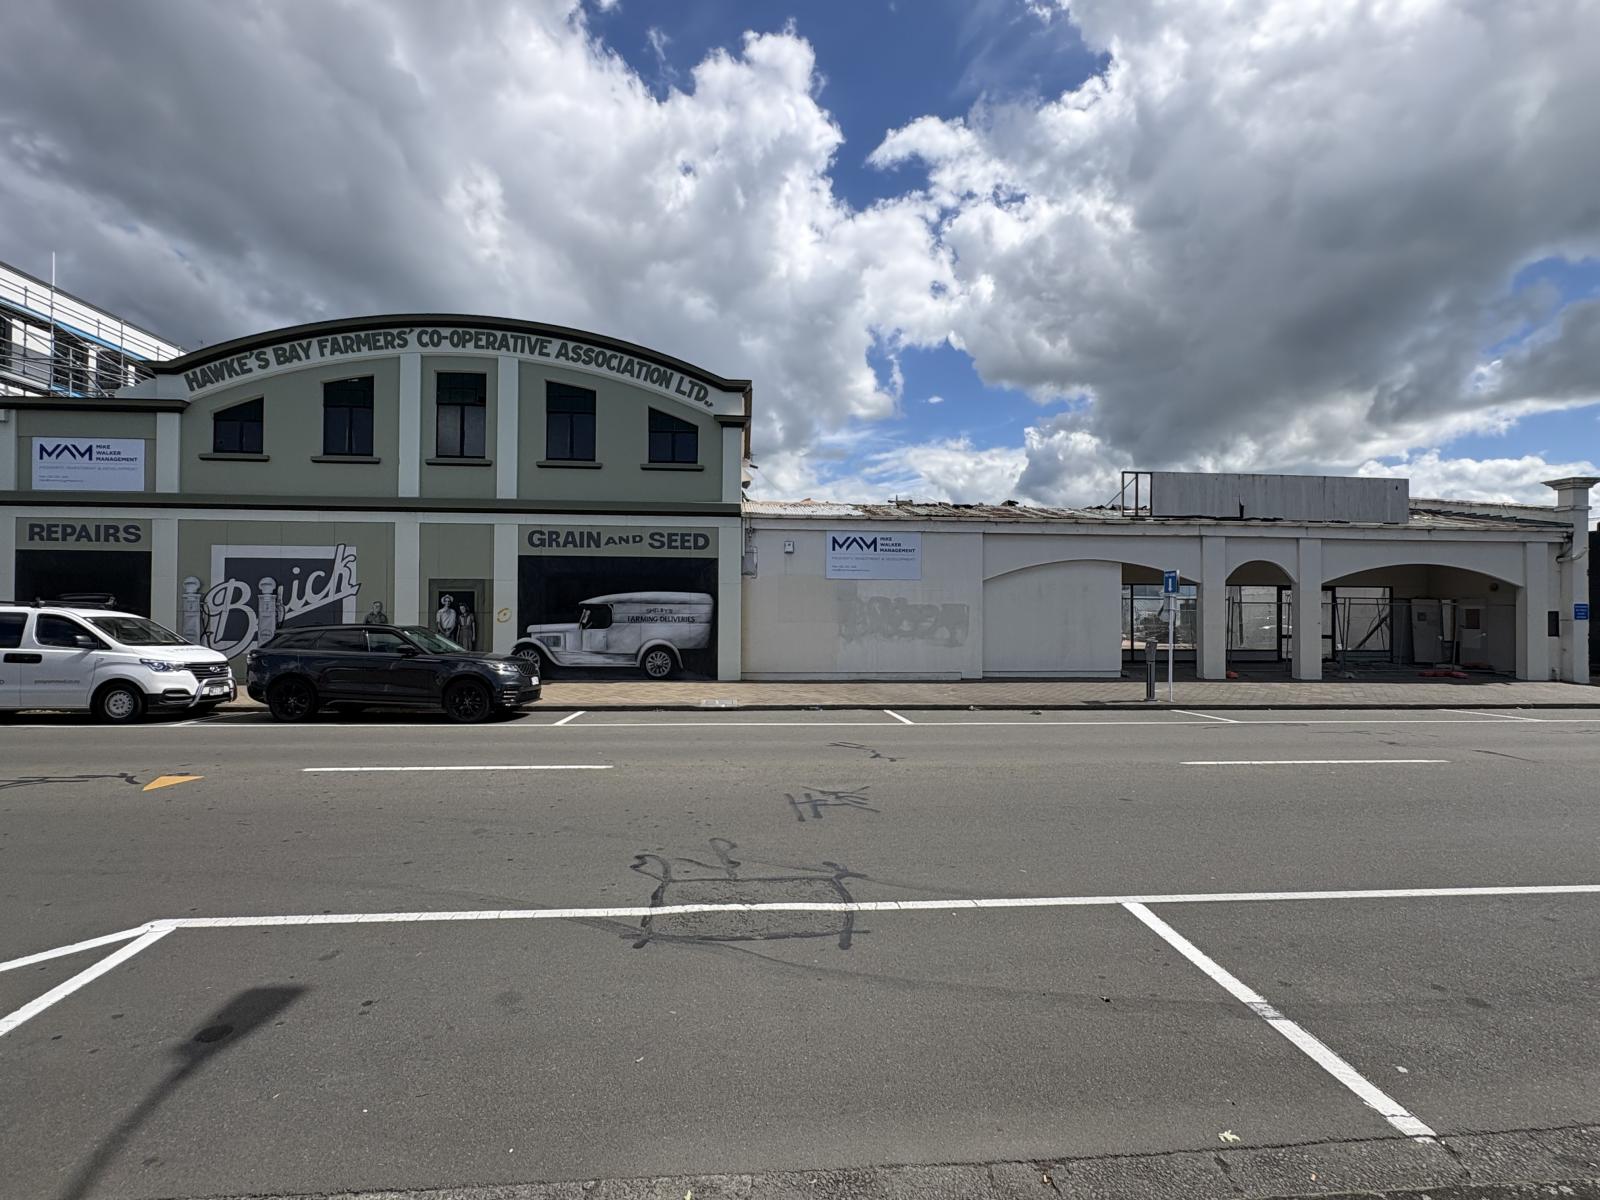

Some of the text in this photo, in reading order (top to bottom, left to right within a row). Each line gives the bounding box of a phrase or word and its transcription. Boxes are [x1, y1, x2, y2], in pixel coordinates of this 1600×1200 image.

[184, 351, 269, 391] HAWKE'S
[273, 343, 311, 366] BAY
[417, 329, 551, 357] CO-OPERATIVE
[555, 342, 674, 389] ASSOCIATION
[28, 523, 142, 543] REPAIRS
[527, 529, 710, 551] GRAIN AND SEED
[627, 615, 696, 623] FARMING DELIVERIES
